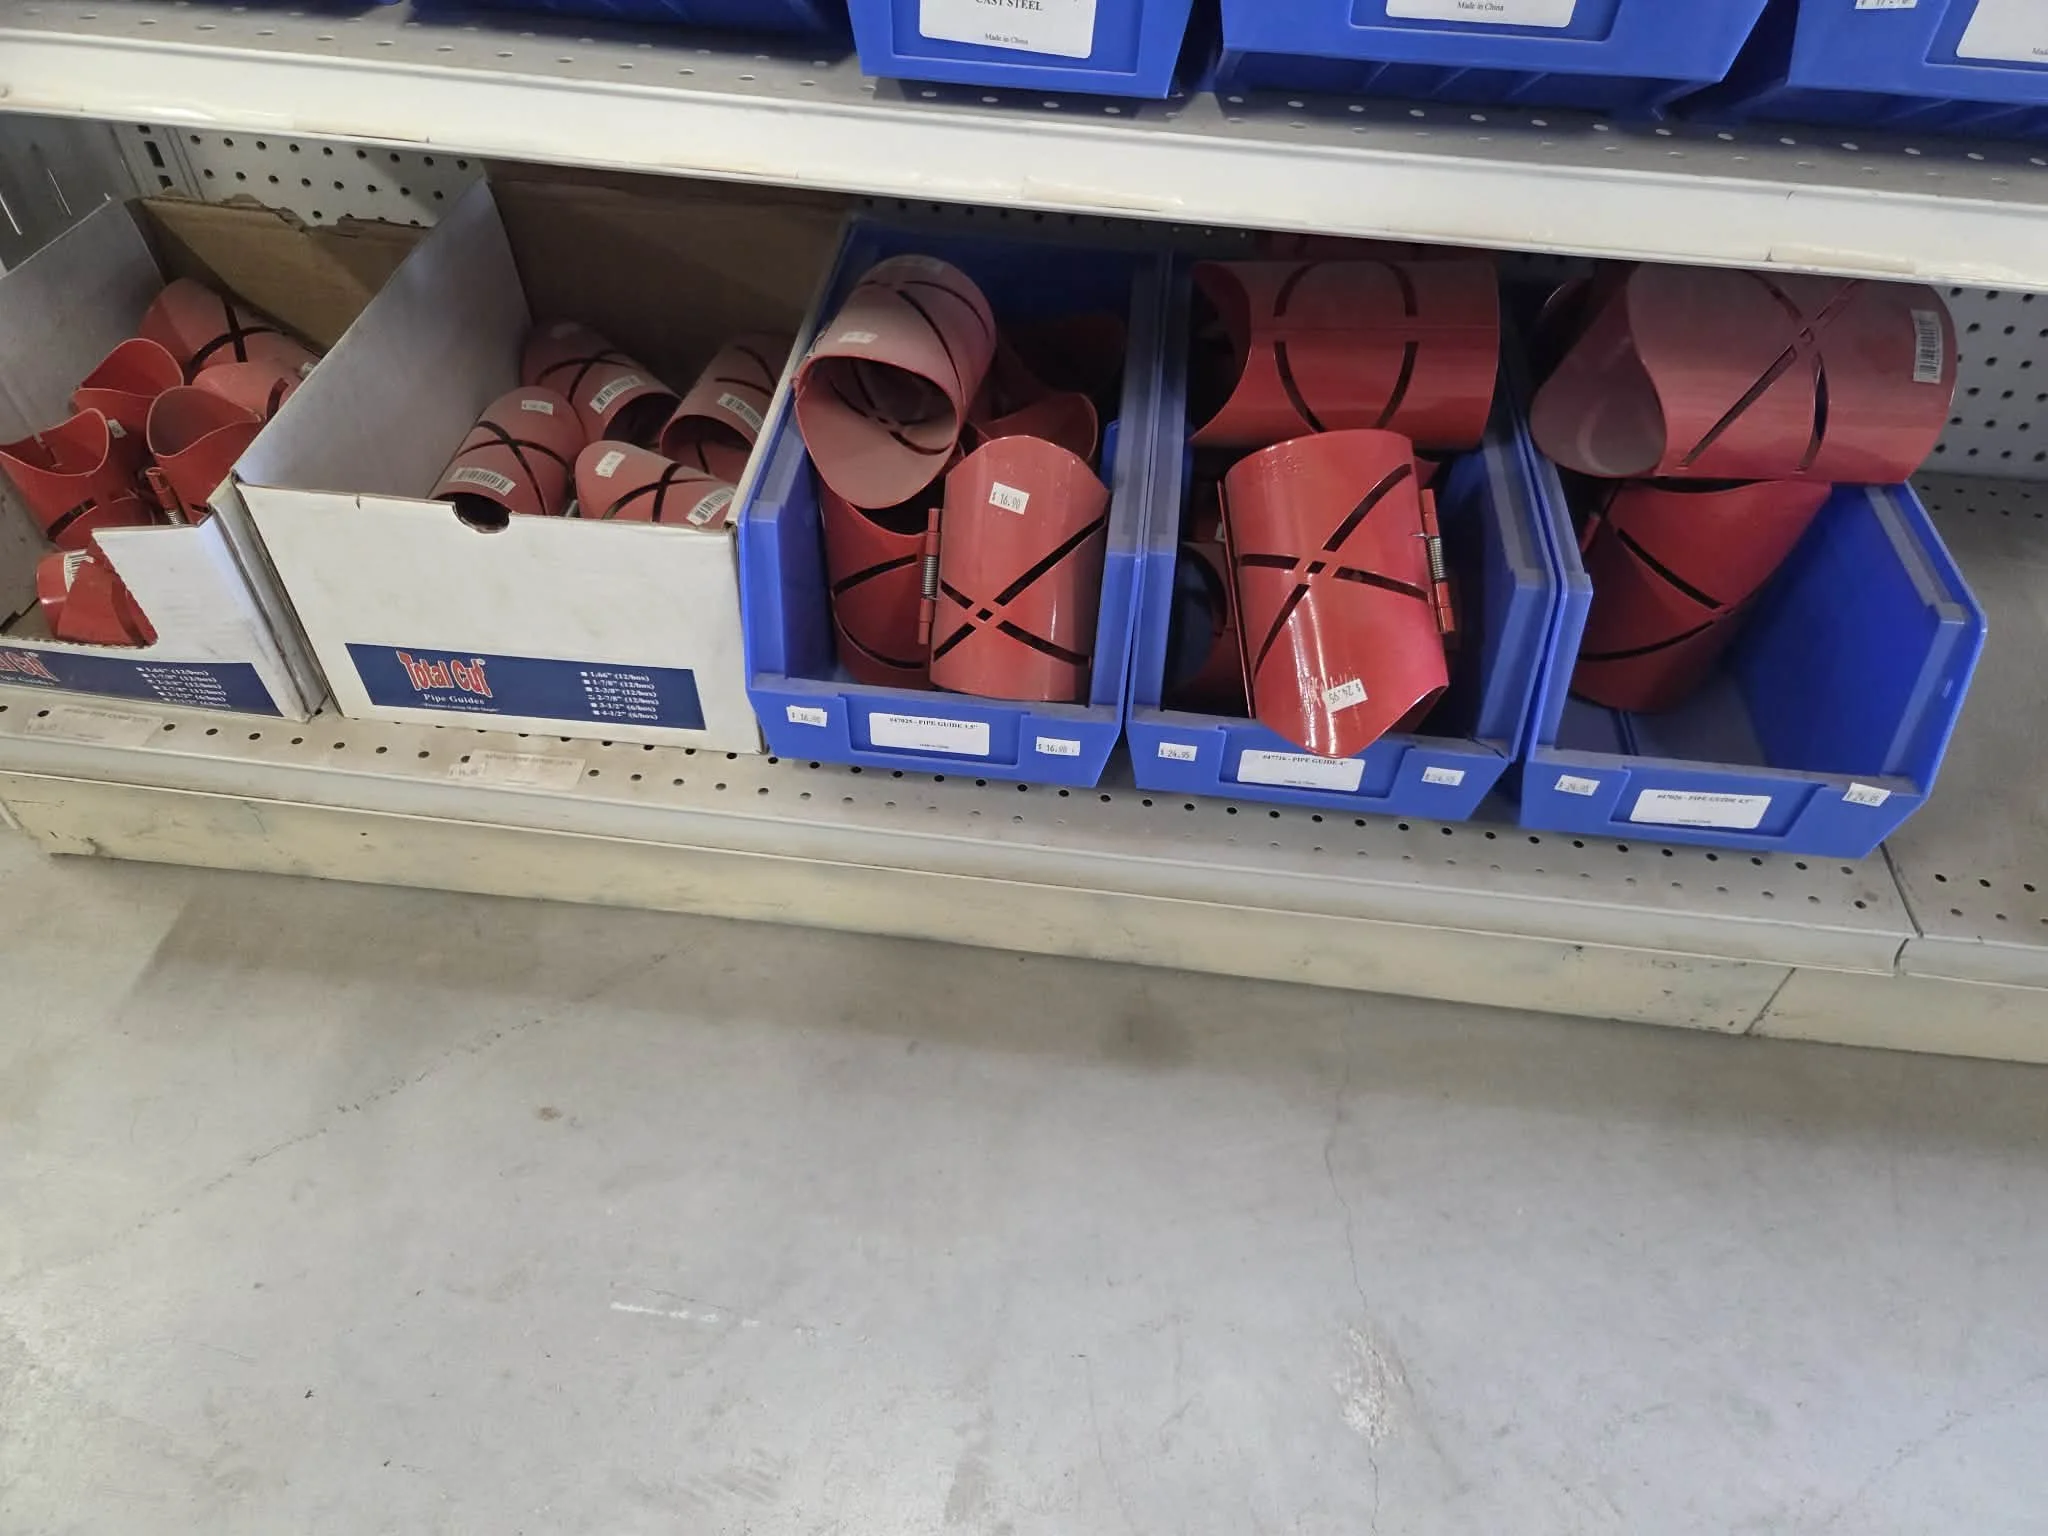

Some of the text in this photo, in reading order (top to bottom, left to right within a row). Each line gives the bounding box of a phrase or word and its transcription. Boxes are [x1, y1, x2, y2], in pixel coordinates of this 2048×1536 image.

[1007, 0, 1044, 11] STEEL
[1457, 2, 1475, 10] Made
[1485, 4, 1504, 12] China
[396, 650, 493, 698] Total Cut
[423, 693, 485, 704] Pipe Guides
